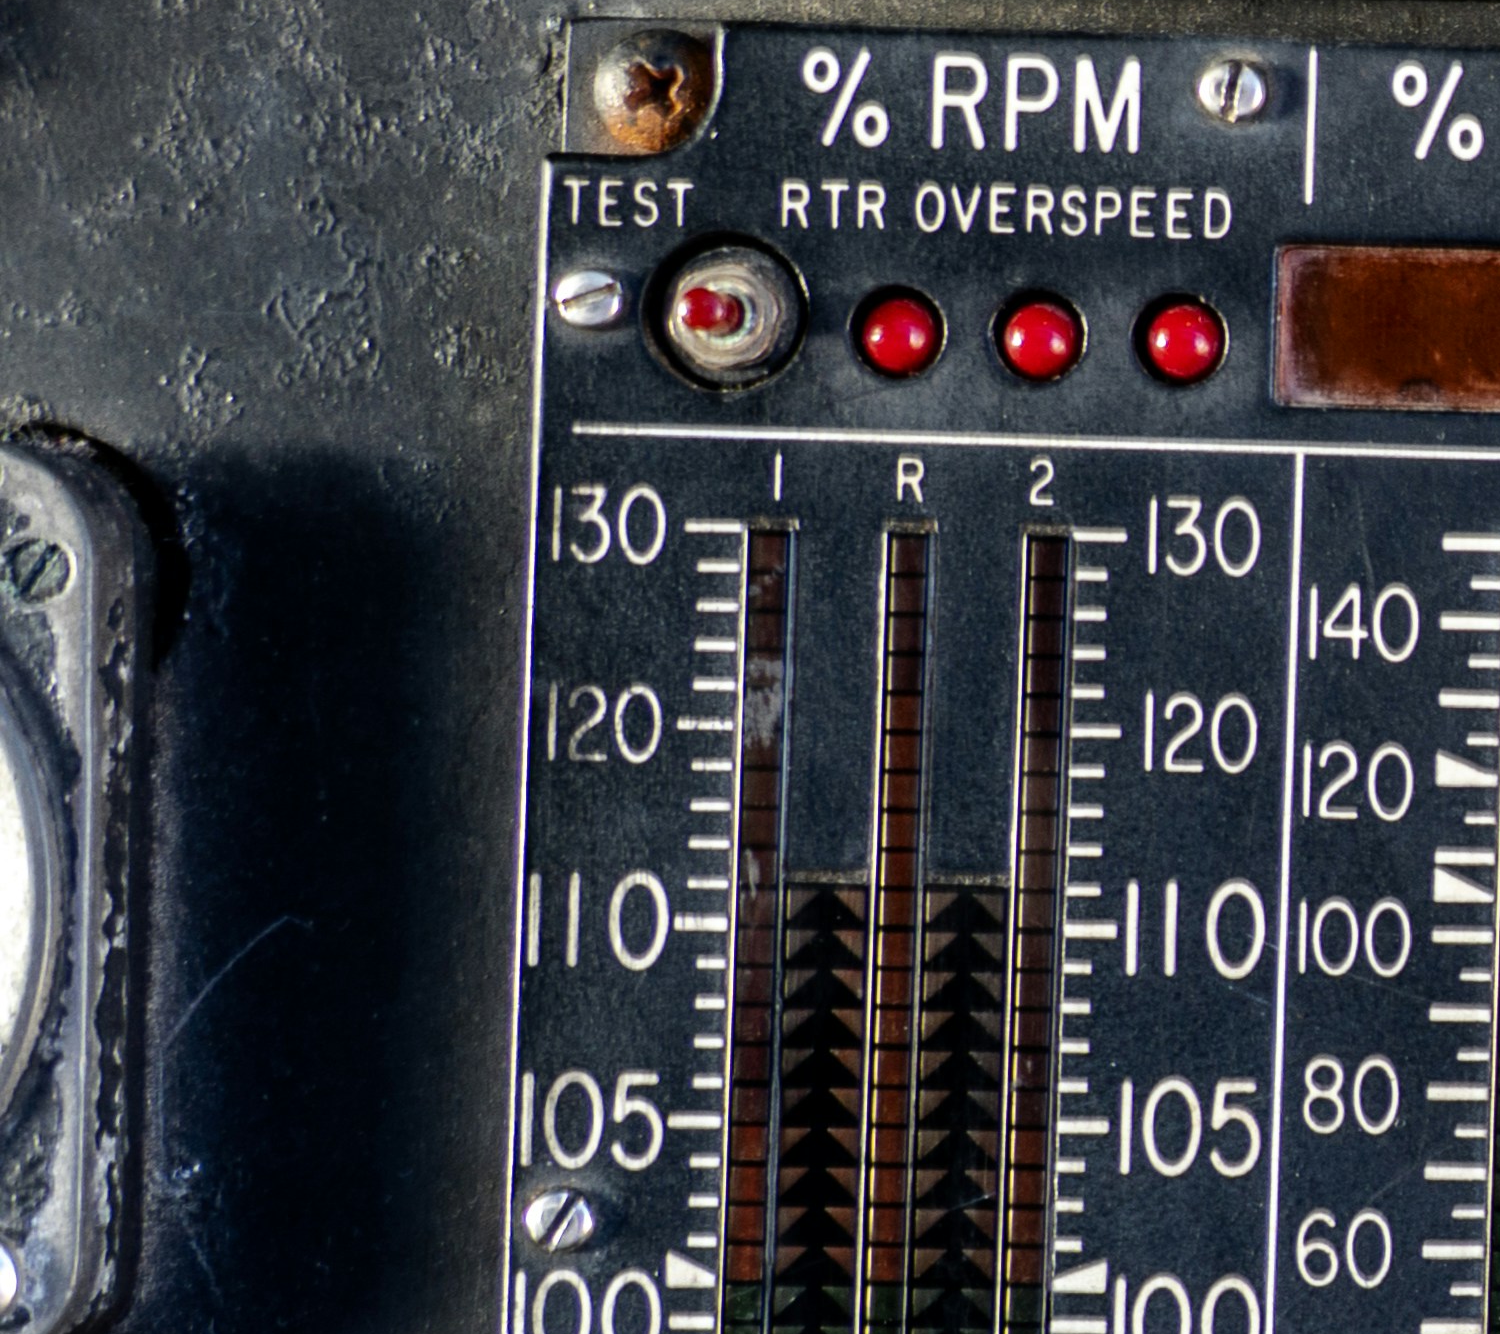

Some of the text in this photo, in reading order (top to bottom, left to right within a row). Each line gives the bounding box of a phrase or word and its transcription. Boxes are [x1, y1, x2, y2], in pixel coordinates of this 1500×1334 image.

[802, 47, 1142, 157] % RPM
[1394, 63, 1485, 164] %
[562, 179, 695, 228] TEST
[780, 183, 1234, 240] RTR OVERSPEED
[896, 458, 925, 503] R
[1029, 458, 1054, 506] 2
[552, 484, 667, 565] 130
[1148, 496, 1262, 578] 130
[1309, 584, 1420, 664] 140
[548, 683, 663, 764] 120
[1145, 689, 1258, 774] 120
[1303, 740, 1414, 822] 120
[527, 871, 670, 971] 110
[1126, 877, 1265, 979] 110
[1299, 899, 1411, 978] 100
[520, 1072, 664, 1170] 105
[1121, 1075, 1261, 1177] 105
[1301, 1057, 1400, 1136] 80
[1297, 1210, 1393, 1289] 60
